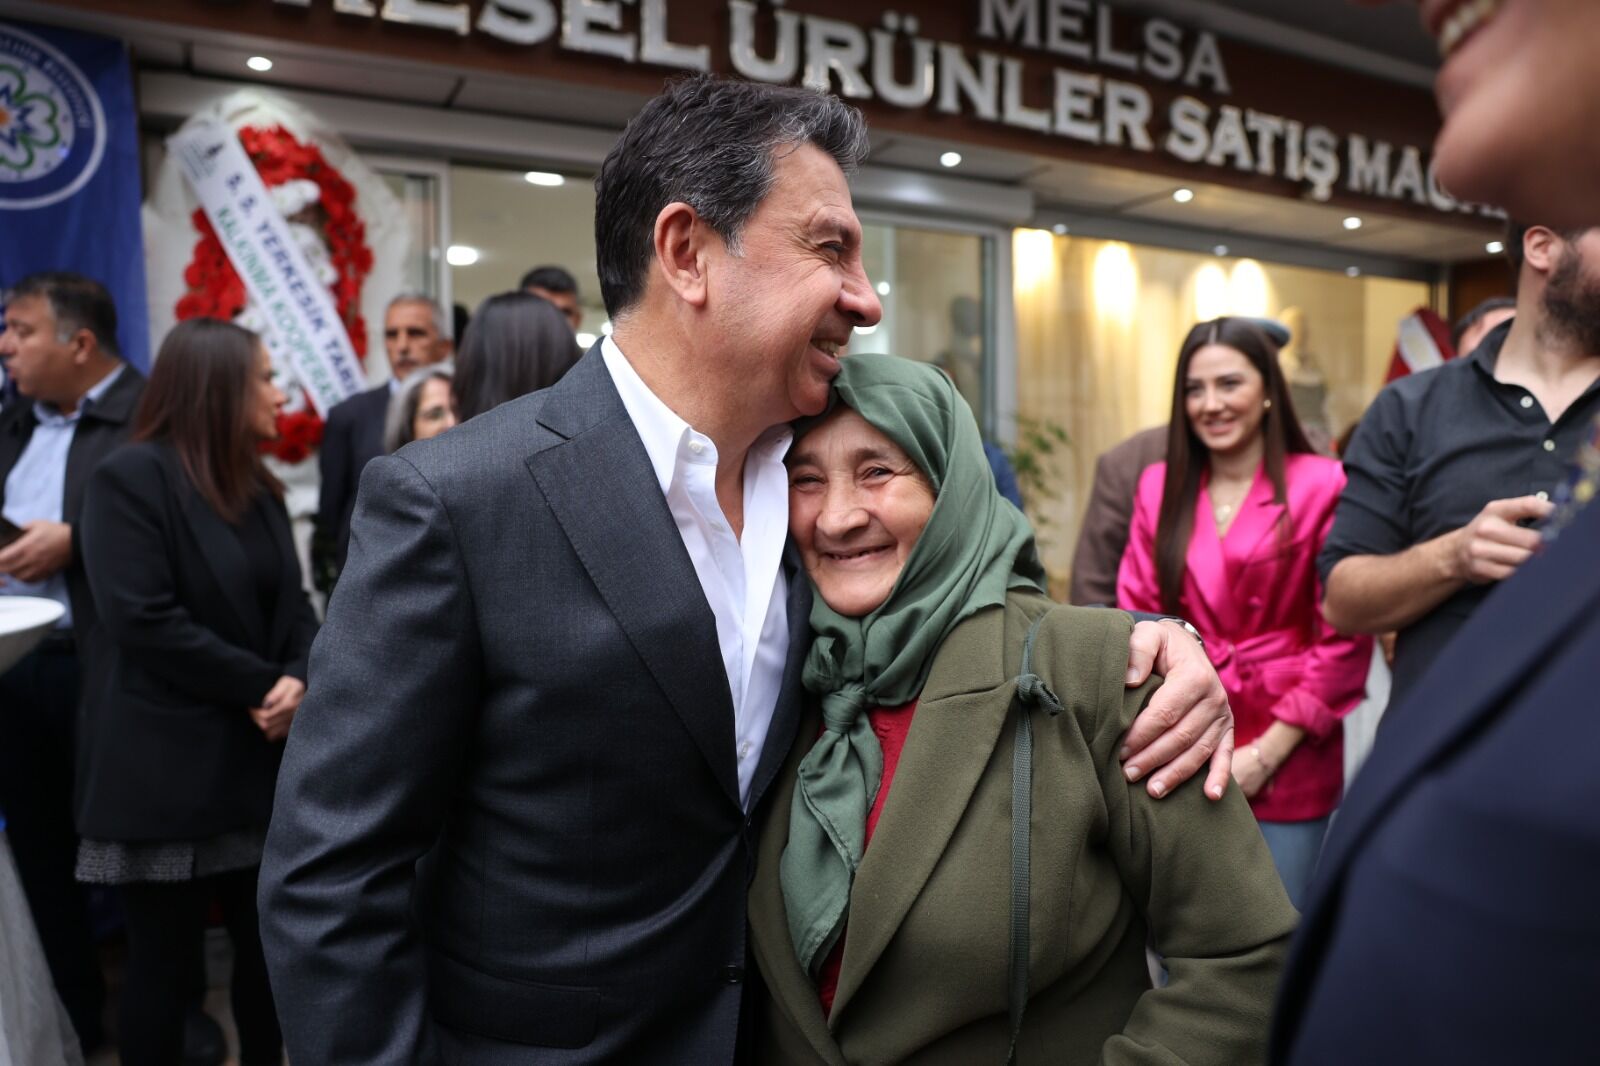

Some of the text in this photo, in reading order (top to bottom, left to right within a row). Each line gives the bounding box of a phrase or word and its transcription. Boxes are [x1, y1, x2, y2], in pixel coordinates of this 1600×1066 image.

[729, 0, 1154, 151] ÜRÜNLER
[1166, 94, 1341, 201] SATIŞ
[977, 0, 1230, 95] MELSA
